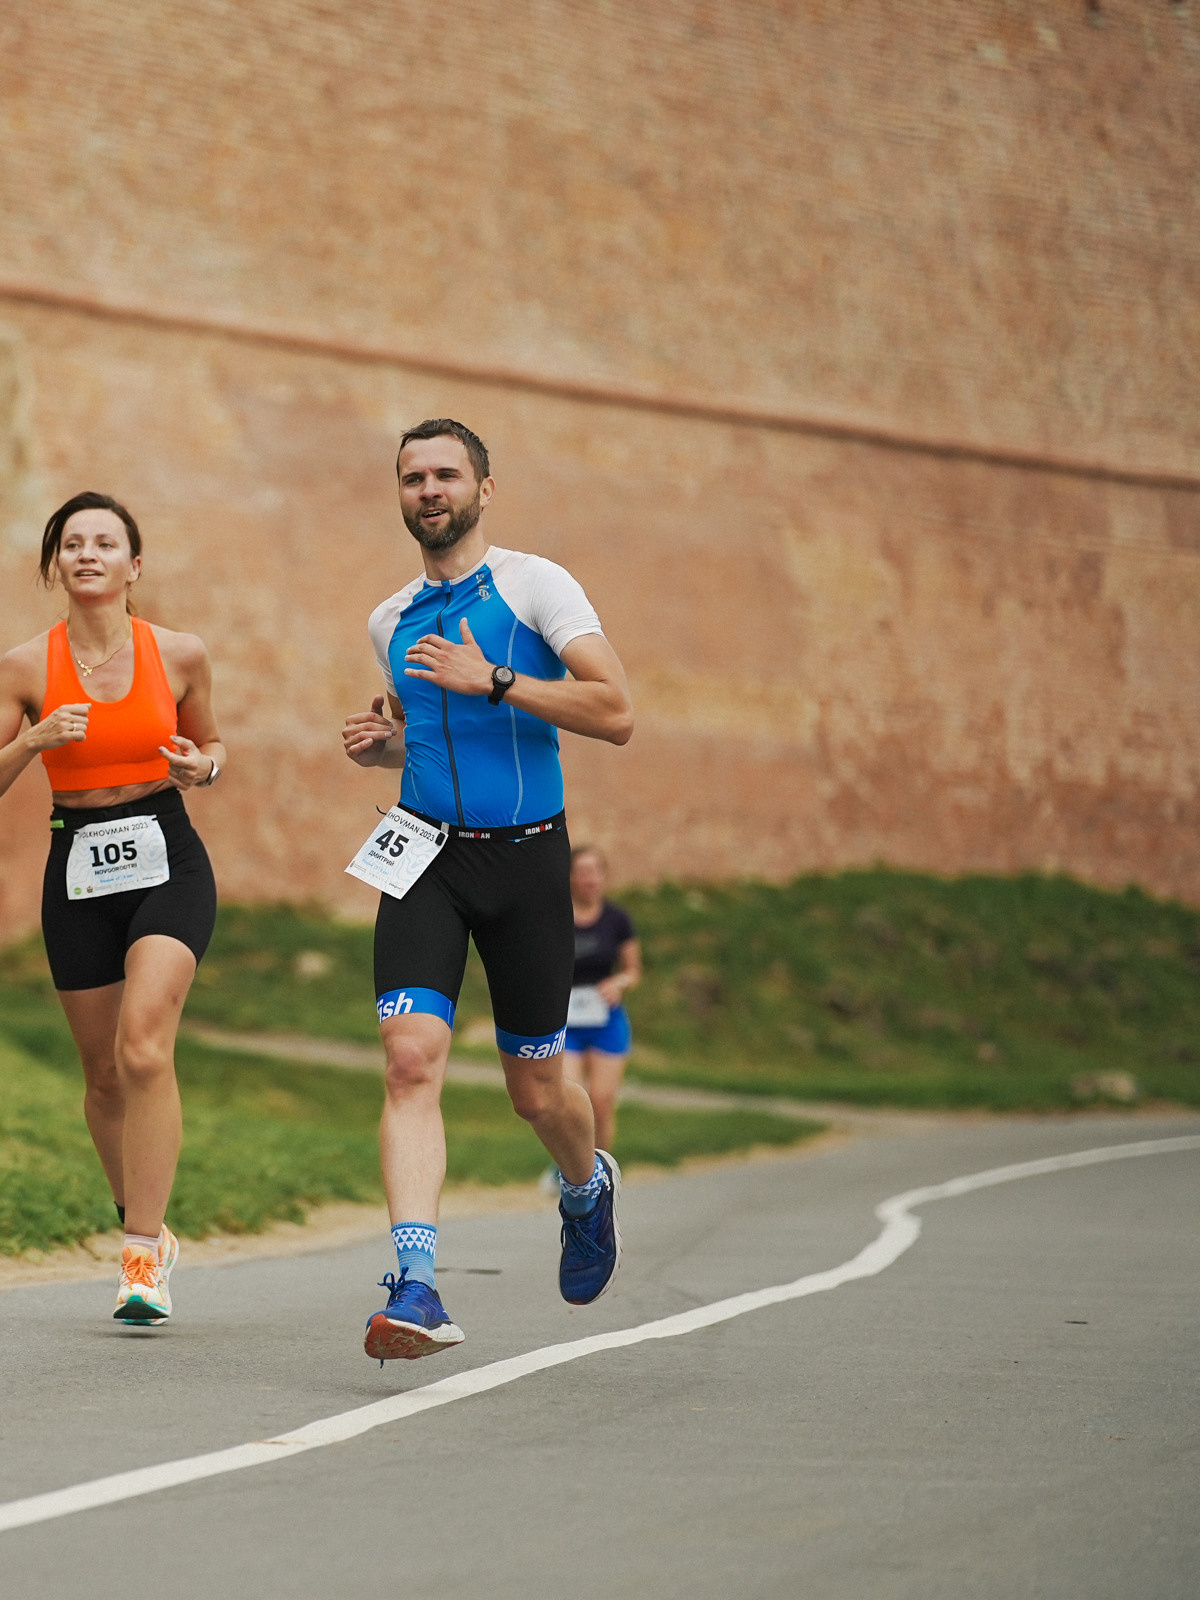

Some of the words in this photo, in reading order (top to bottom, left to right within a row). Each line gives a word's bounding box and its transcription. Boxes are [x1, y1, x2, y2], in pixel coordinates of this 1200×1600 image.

[132, 822, 149, 831] 2023
[419, 829, 435, 841] 2023
[375, 829, 410, 857] 45
[90, 840, 138, 867] 105
